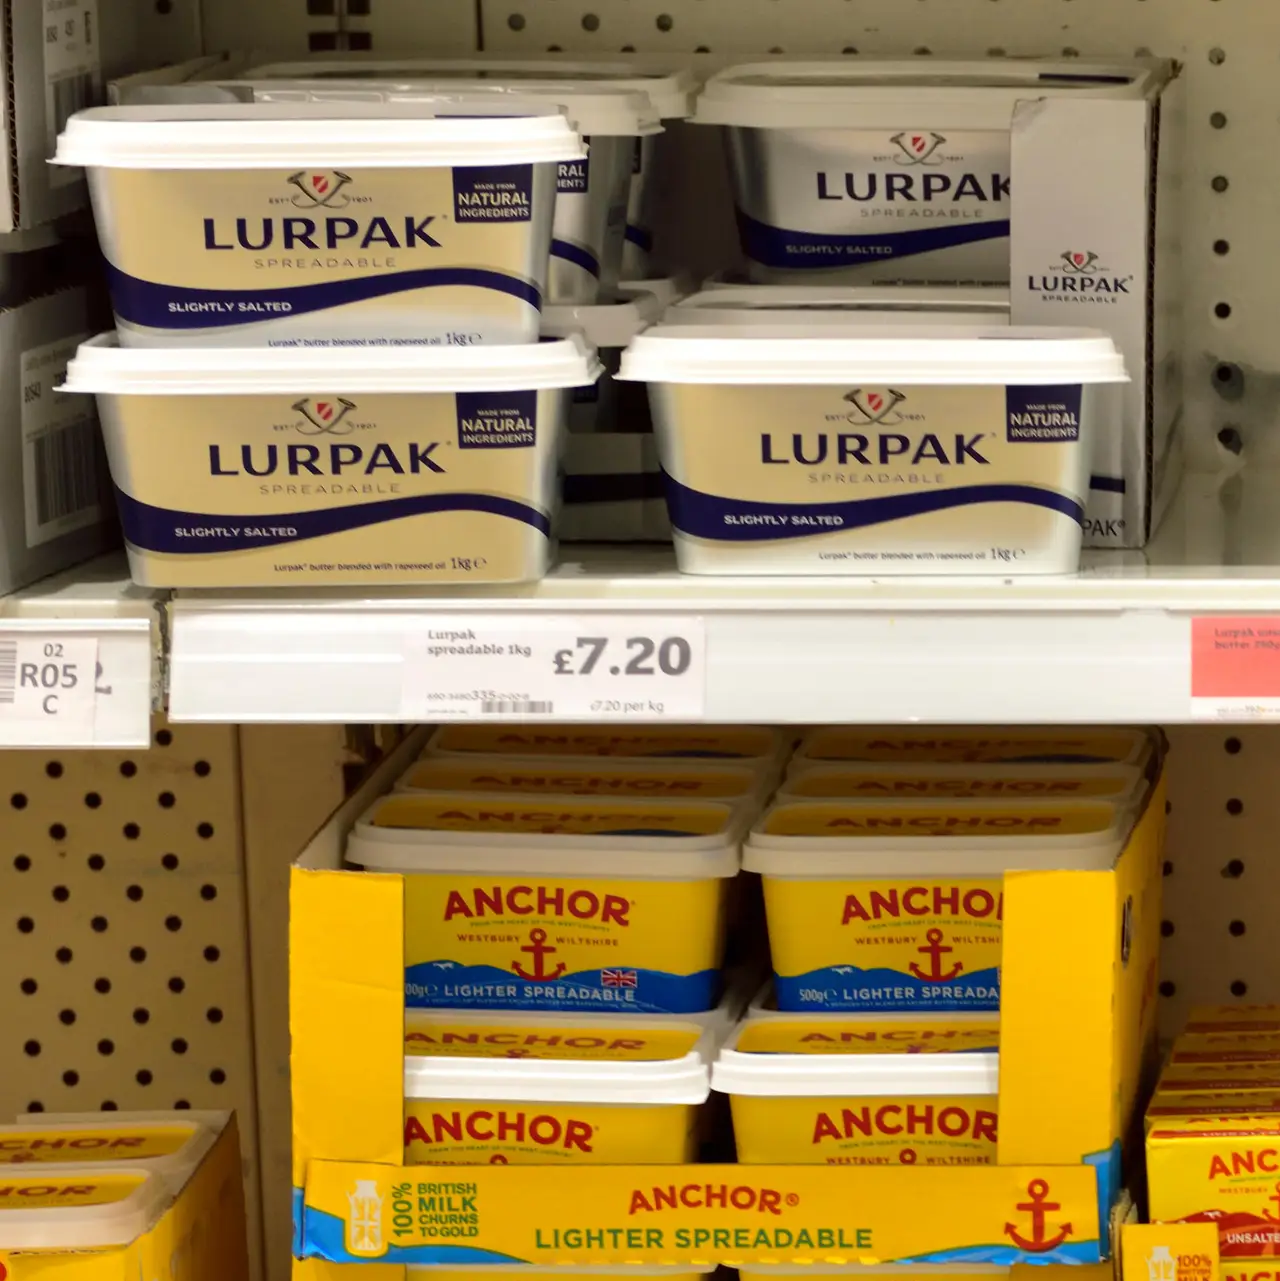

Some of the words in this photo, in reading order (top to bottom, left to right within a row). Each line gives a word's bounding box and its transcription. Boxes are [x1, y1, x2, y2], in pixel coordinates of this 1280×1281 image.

[458, 193, 529, 206] NATURAL
[459, 207, 528, 218] INGREDIENTS
[204, 216, 442, 250] LURPAK
[254, 258, 396, 269] SPREADABLE
[1028, 275, 1129, 293] LURPAK
[168, 302, 234, 312] SLIGHTLY
[238, 302, 292, 311] SALTED
[1011, 412, 1078, 428] NATURAL
[1011, 427, 1077, 438] INGREDIENTS
[760, 434, 990, 465] LURPAK
[209, 442, 446, 476] LURPAK
[724, 515, 788, 526] SLIGHTLY
[791, 515, 843, 525] SALTED
[428, 629, 476, 643] Lurpak
[44, 643, 64, 658] 02
[427, 644, 503, 658] spreadable
[508, 644, 531, 657] 1kg
[553, 637, 691, 676] £7.20
[20, 664, 77, 688] R05
[43, 695, 57, 715] C
[444, 886, 631, 927] ANCHOR
[457, 934, 522, 944] WESTBURY
[556, 936, 618, 947] WILTSHIRE
[444, 984, 518, 998] LIGHTER
[524, 986, 634, 1001] SPREADABLE
[535, 1228, 665, 1249] LIGHTER
[675, 1228, 872, 1249] SPREADABLE
